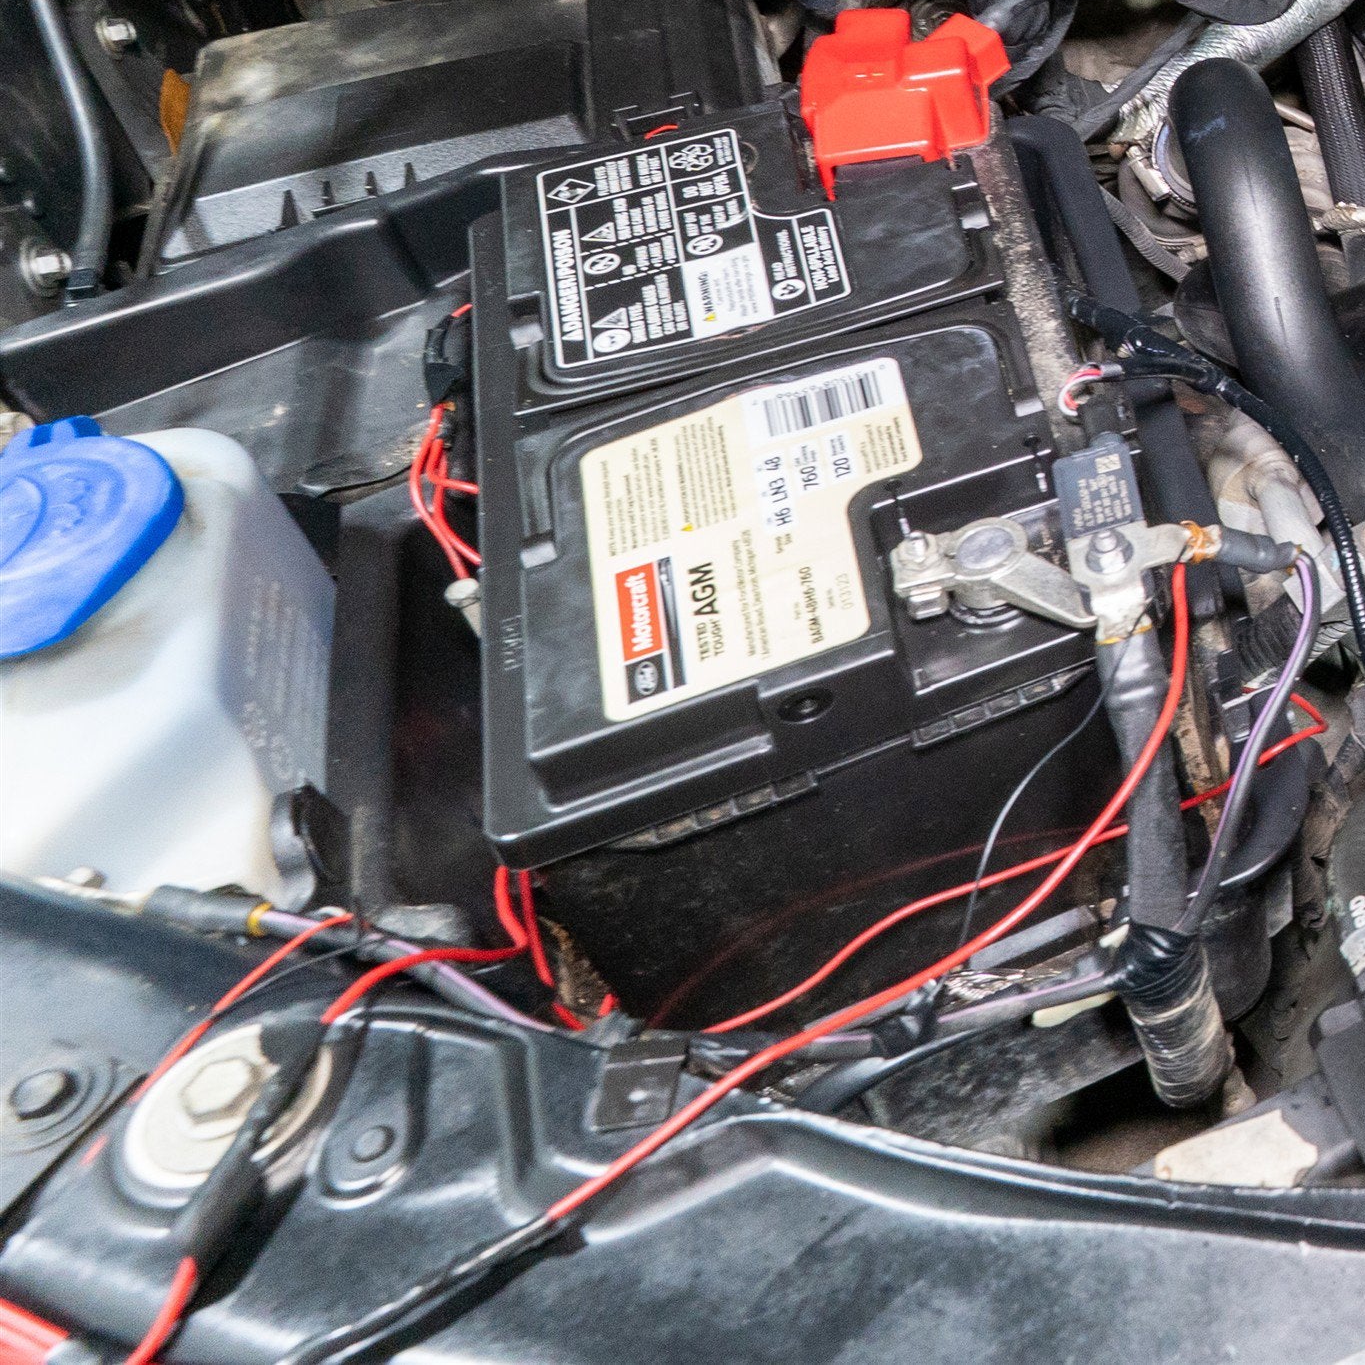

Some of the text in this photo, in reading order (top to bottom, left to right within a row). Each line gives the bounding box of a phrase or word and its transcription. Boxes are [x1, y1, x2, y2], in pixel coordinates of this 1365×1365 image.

[553, 230, 581, 330] DANGER/POISON
[764, 456, 791, 526] H6 LN3 48
[800, 466, 818, 490] 760
[833, 457, 851, 477] 120
[626, 573, 652, 650] Motorcraft
[689, 563, 718, 615] AGM
[799, 567, 823, 643] BAGM-48H6-760
[696, 622, 709, 660] TESTED
